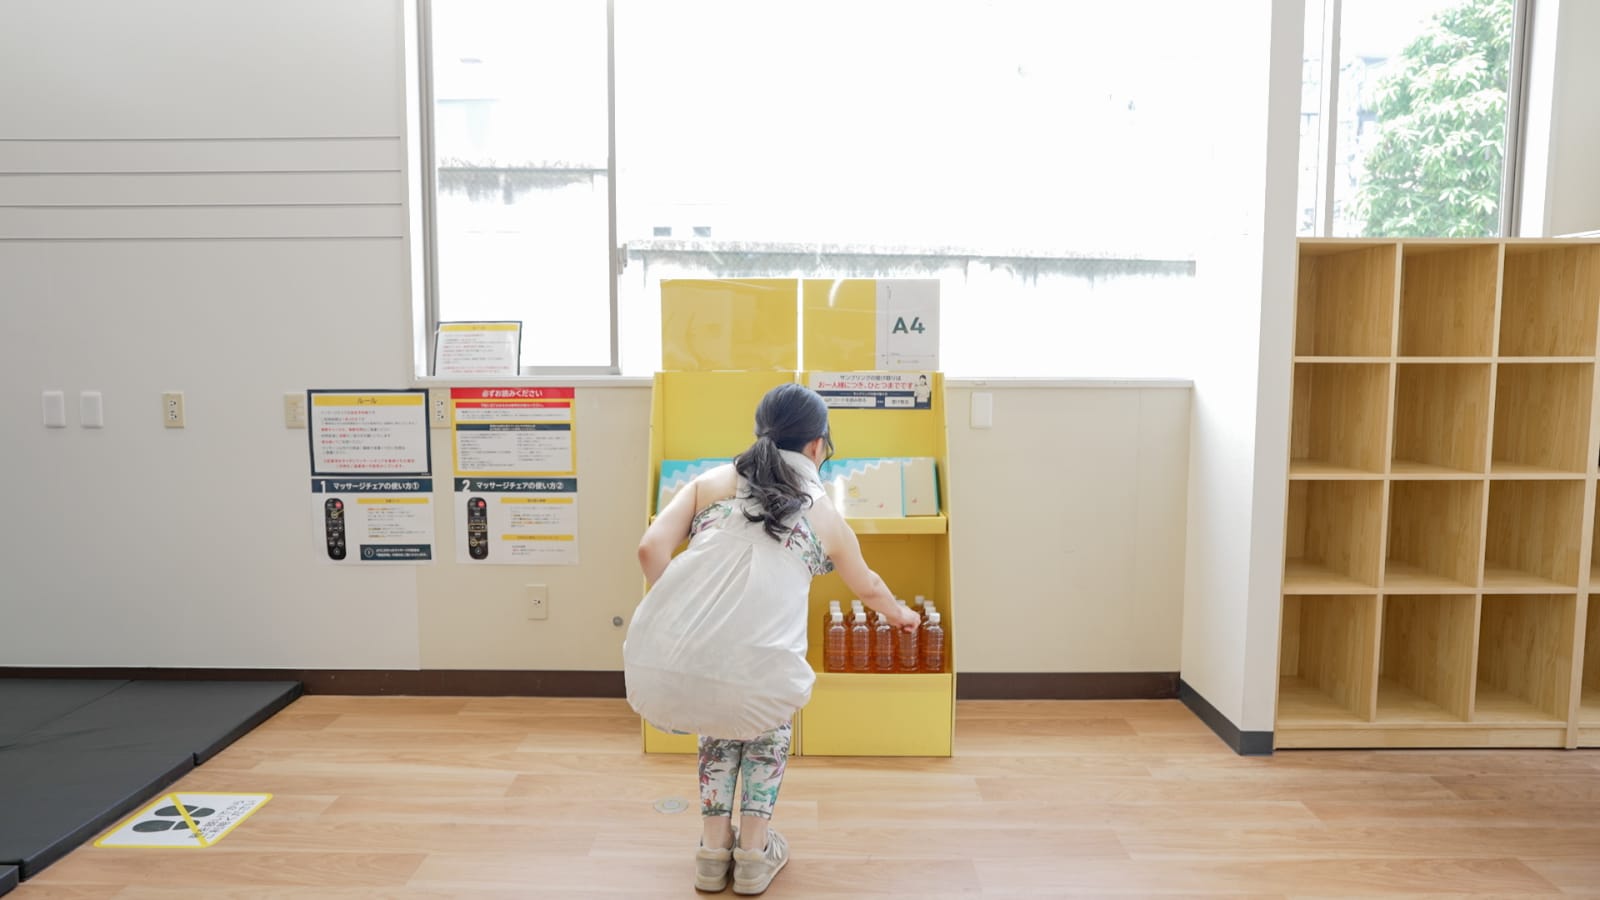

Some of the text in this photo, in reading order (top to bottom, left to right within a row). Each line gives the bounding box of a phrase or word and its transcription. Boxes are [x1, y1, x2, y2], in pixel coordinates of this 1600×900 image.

[892, 316, 925, 334] A4
[482, 389, 543, 397] 必ずお読みください
[320, 480, 420, 493] 1 マッサージチェアの使い方①
[462, 480, 564, 493] 2 マッサージチェアの使い方②
